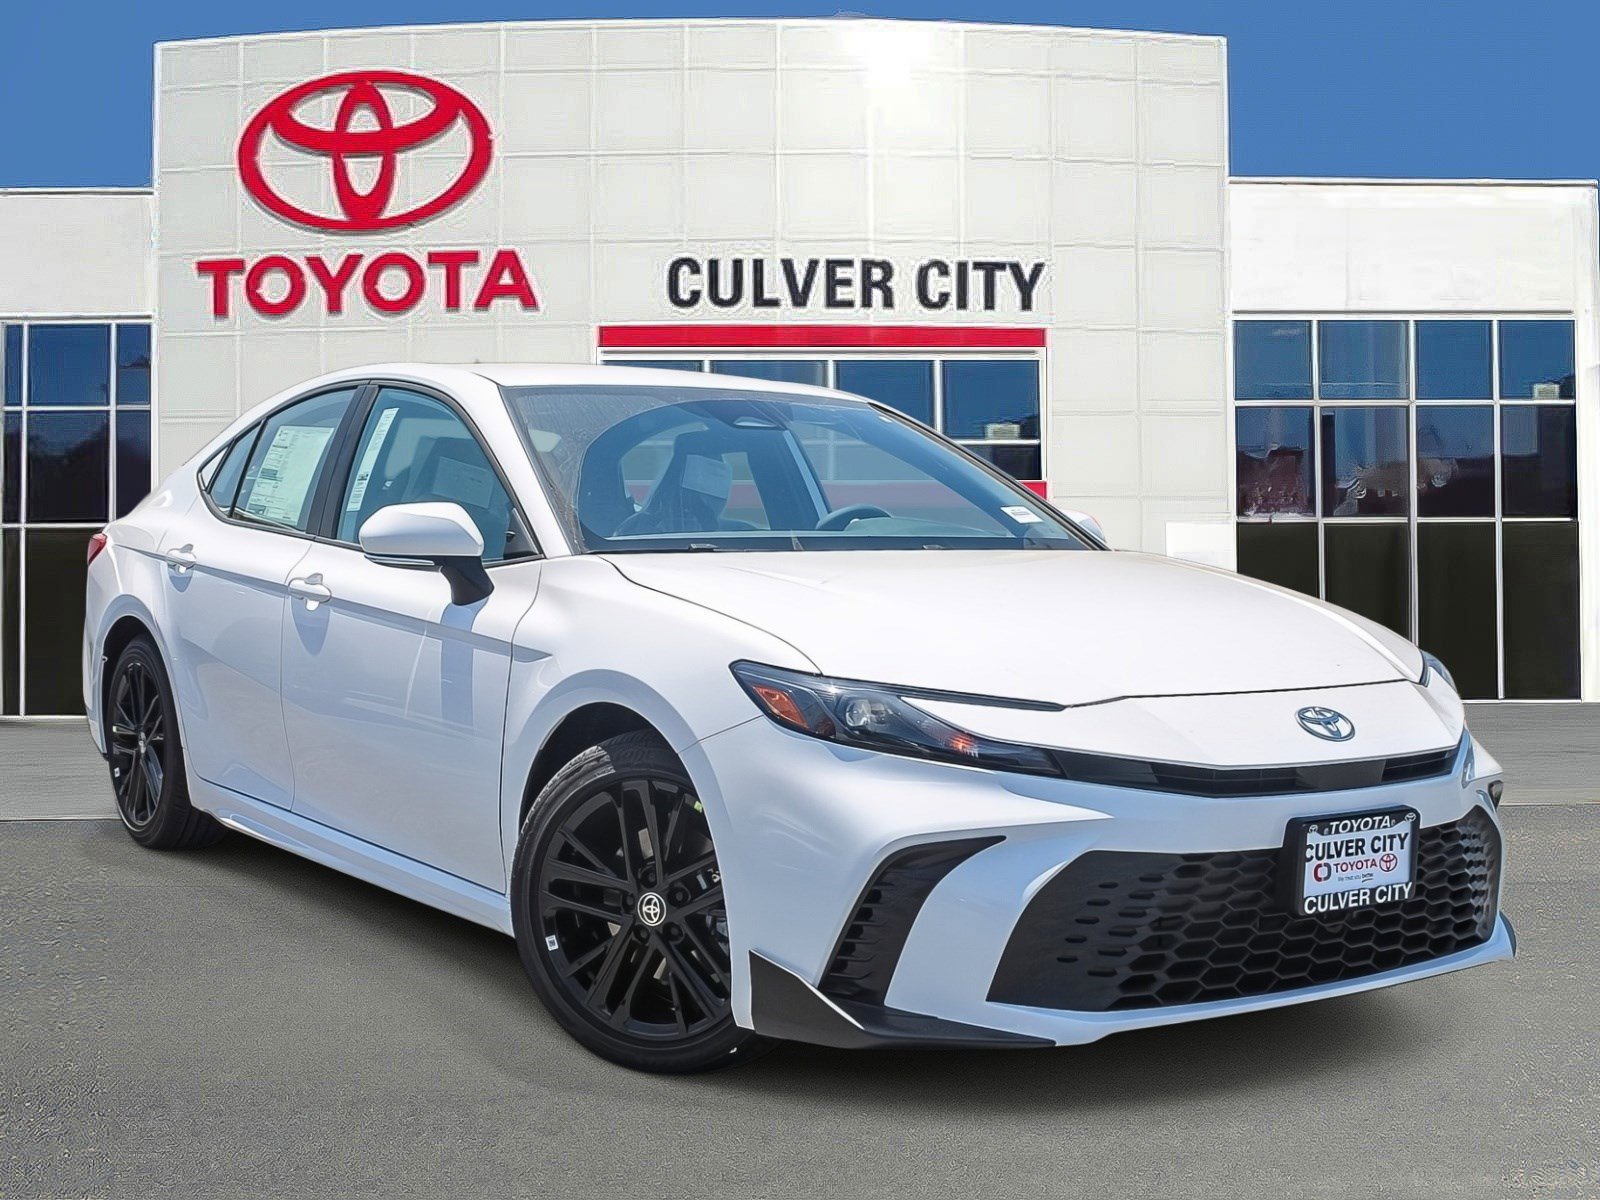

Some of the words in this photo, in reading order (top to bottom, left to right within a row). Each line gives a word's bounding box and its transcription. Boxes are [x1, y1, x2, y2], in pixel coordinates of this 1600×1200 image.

[196, 249, 540, 319] TOYOTA
[667, 256, 896, 309] CULVER
[915, 258, 1046, 312] CITY
[1329, 815, 1391, 835] TOYOTA
[1305, 837, 1366, 863] CULVER
[1370, 832, 1409, 854] CITY
[1333, 858, 1378, 873] TOYOTA
[1303, 888, 1371, 915] CULVER
[1375, 881, 1413, 904] CITY
